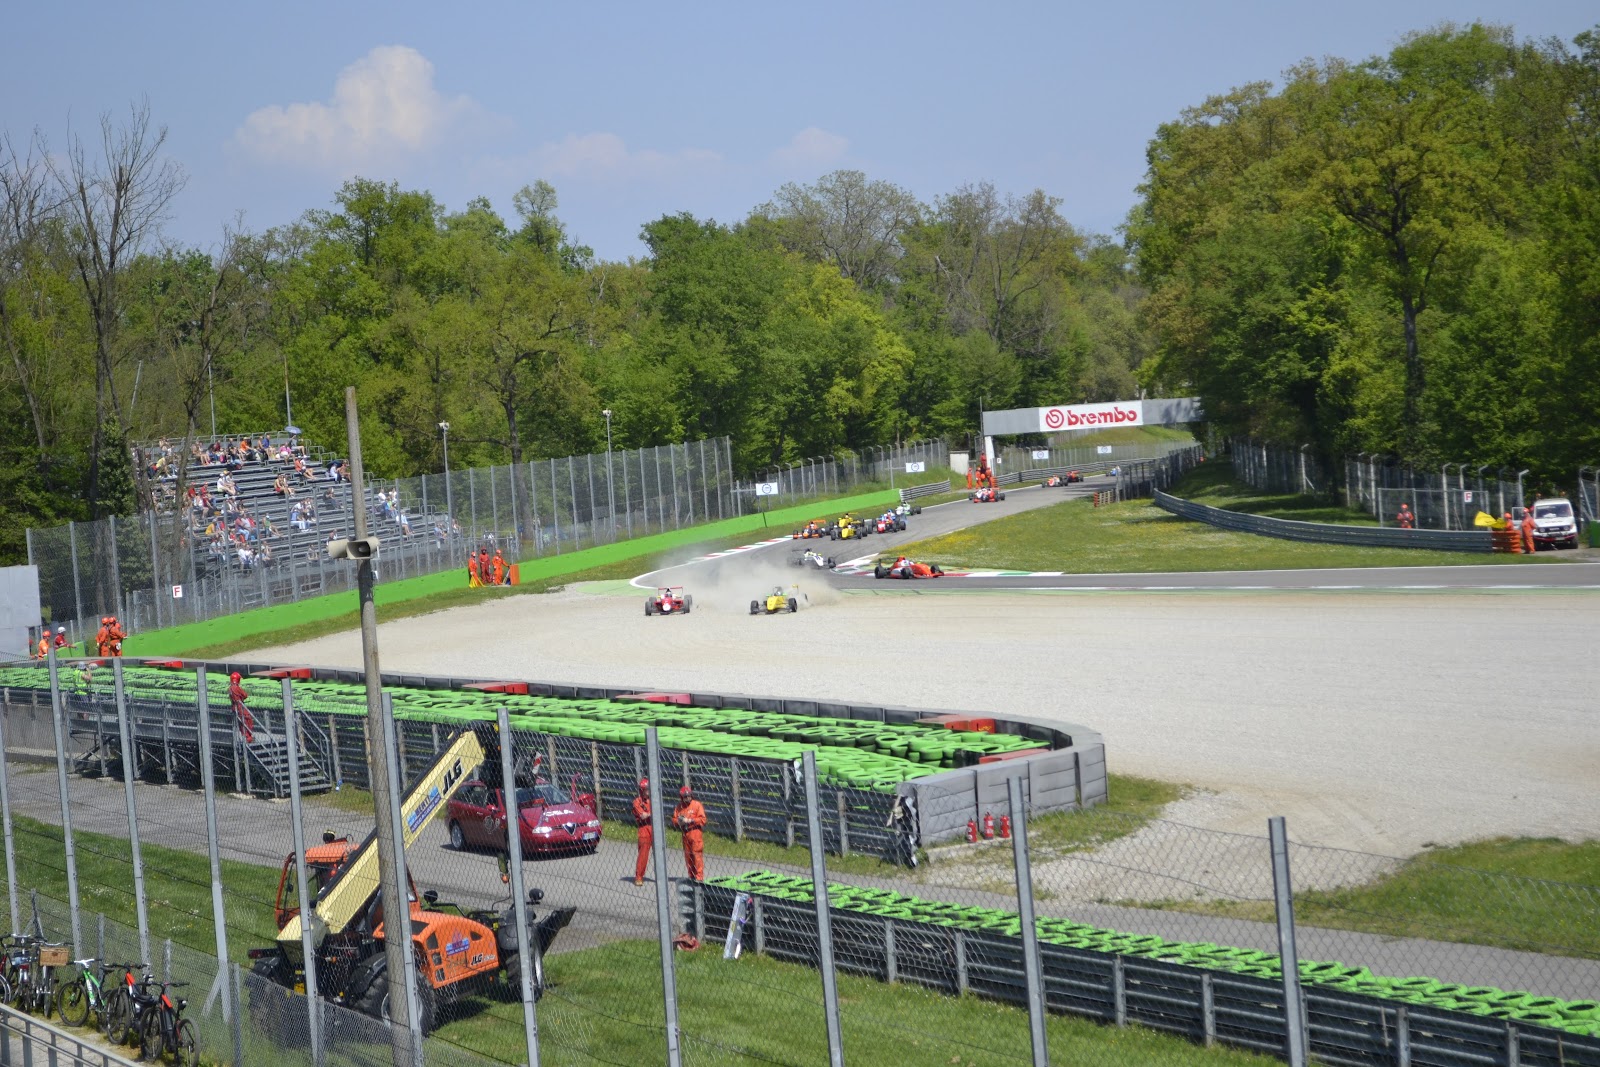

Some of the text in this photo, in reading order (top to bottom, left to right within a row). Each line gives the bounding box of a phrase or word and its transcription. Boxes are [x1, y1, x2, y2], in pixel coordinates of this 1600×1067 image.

[1067, 406, 1138, 426] brembo
[174, 587, 180, 596] F
[443, 757, 463, 795] JLG
[471, 953, 483, 966] JLG
